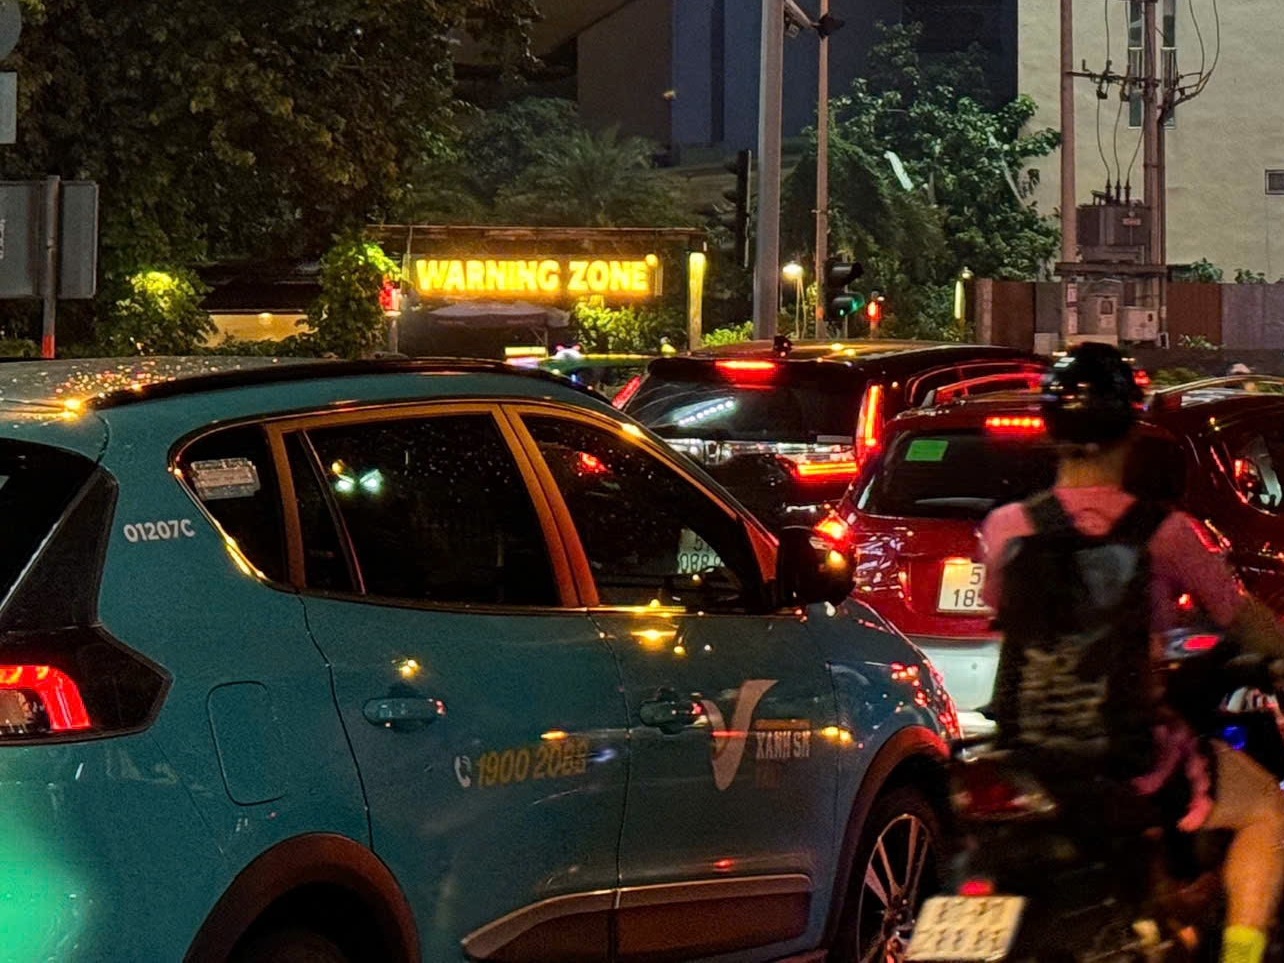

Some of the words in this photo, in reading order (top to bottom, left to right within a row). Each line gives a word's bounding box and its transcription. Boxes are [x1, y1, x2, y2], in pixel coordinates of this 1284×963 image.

[415, 259, 561, 292] WARNING
[567, 259, 650, 292] ZONE
[123, 519, 196, 543] 01207C
